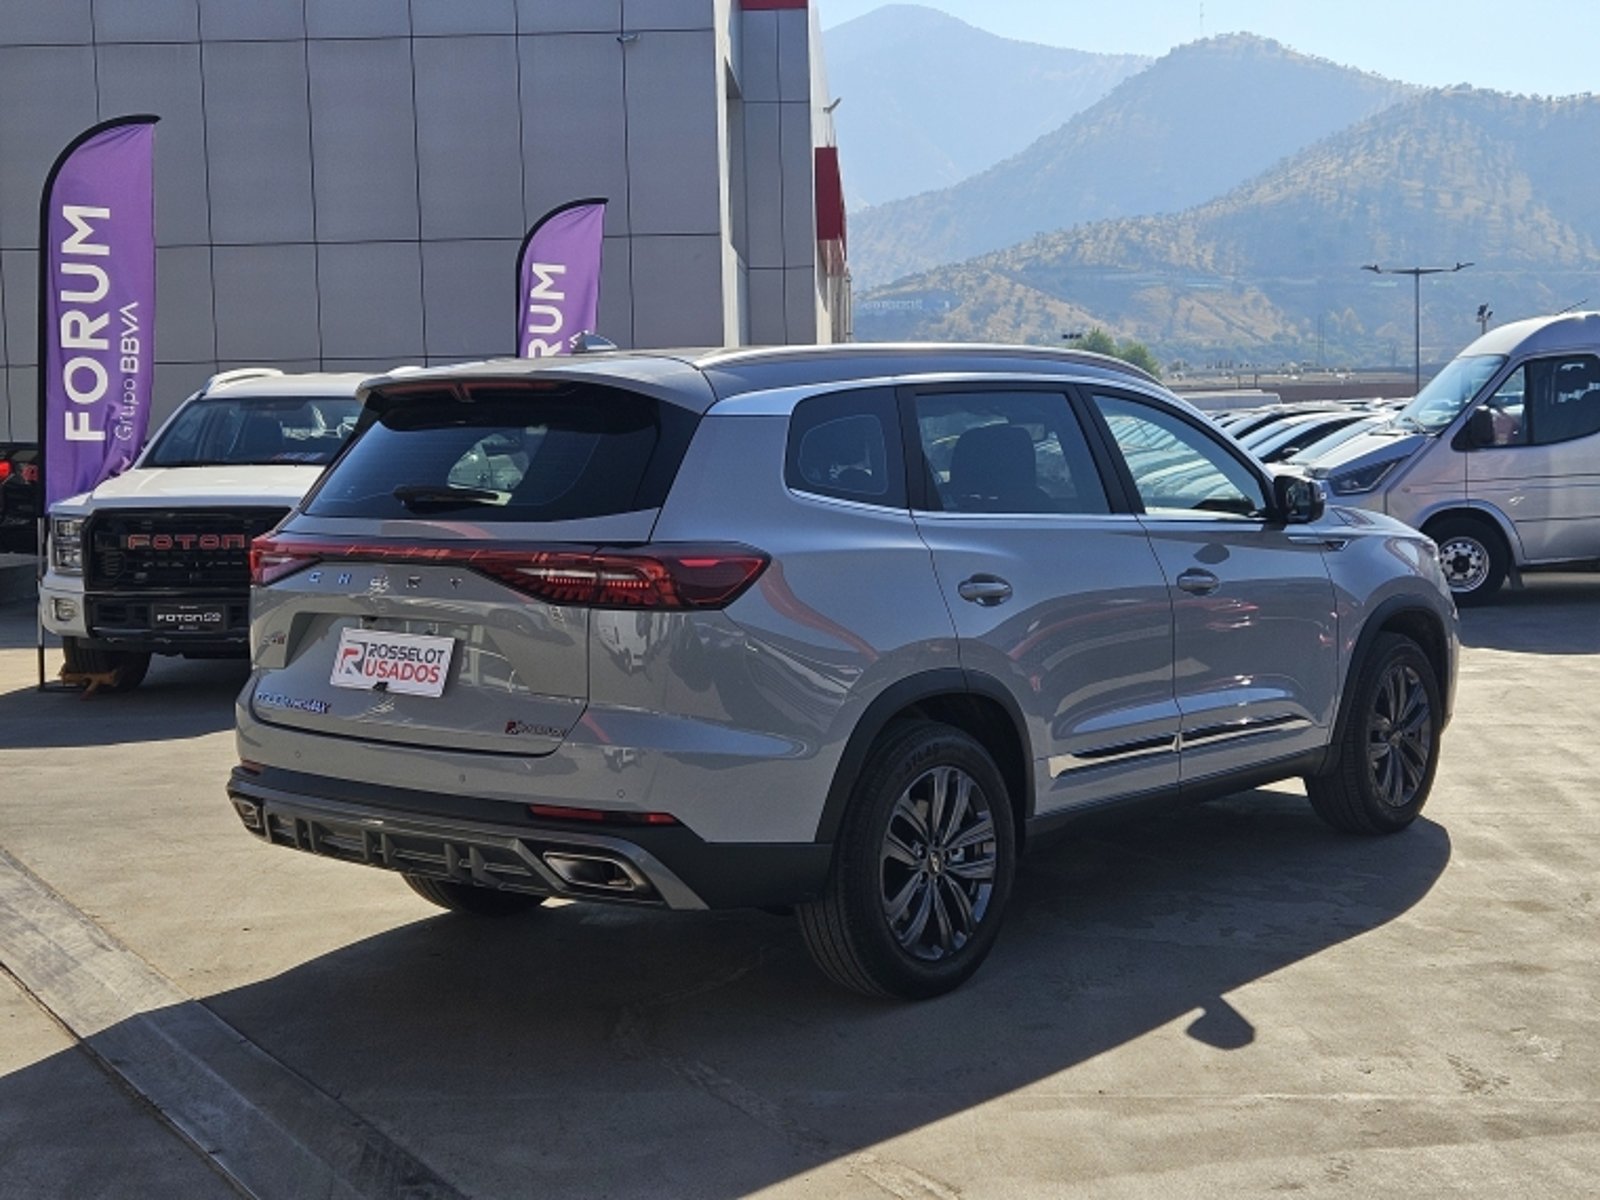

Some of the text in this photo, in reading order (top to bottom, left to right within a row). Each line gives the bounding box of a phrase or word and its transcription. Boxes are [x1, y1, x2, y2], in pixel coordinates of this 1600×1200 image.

[61, 205, 110, 441] FORUM
[115, 301, 140, 441] Grupo BBVA
[128, 534, 245, 550] FOTON
[368, 643, 445, 664] ROSSELOT
[365, 659, 440, 683] USADOS
